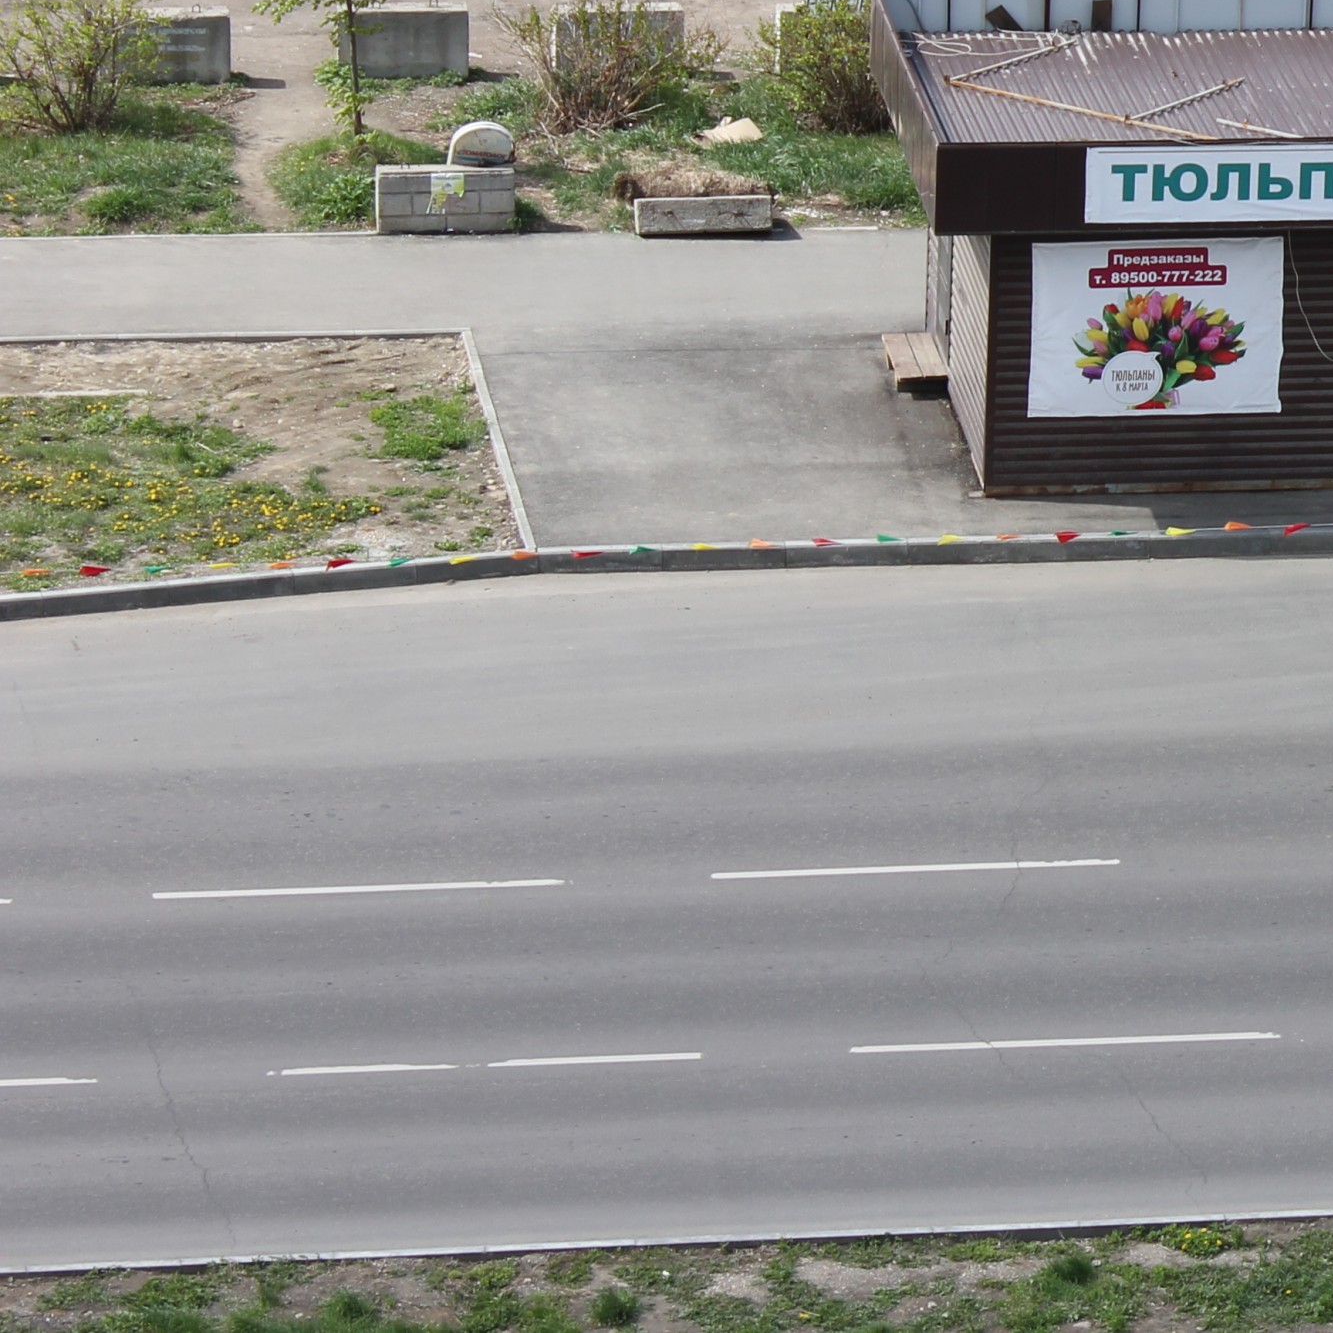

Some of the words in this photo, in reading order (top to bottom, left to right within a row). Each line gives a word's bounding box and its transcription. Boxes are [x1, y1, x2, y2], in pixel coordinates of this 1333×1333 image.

[1113, 254, 1204, 266] Предзаказы
[1111, 270, 1222, 283] 89500-777-222
[1112, 370, 1155, 381] ТЮЛЬПАНЫ
[1129, 383, 1148, 391] МАРТА
